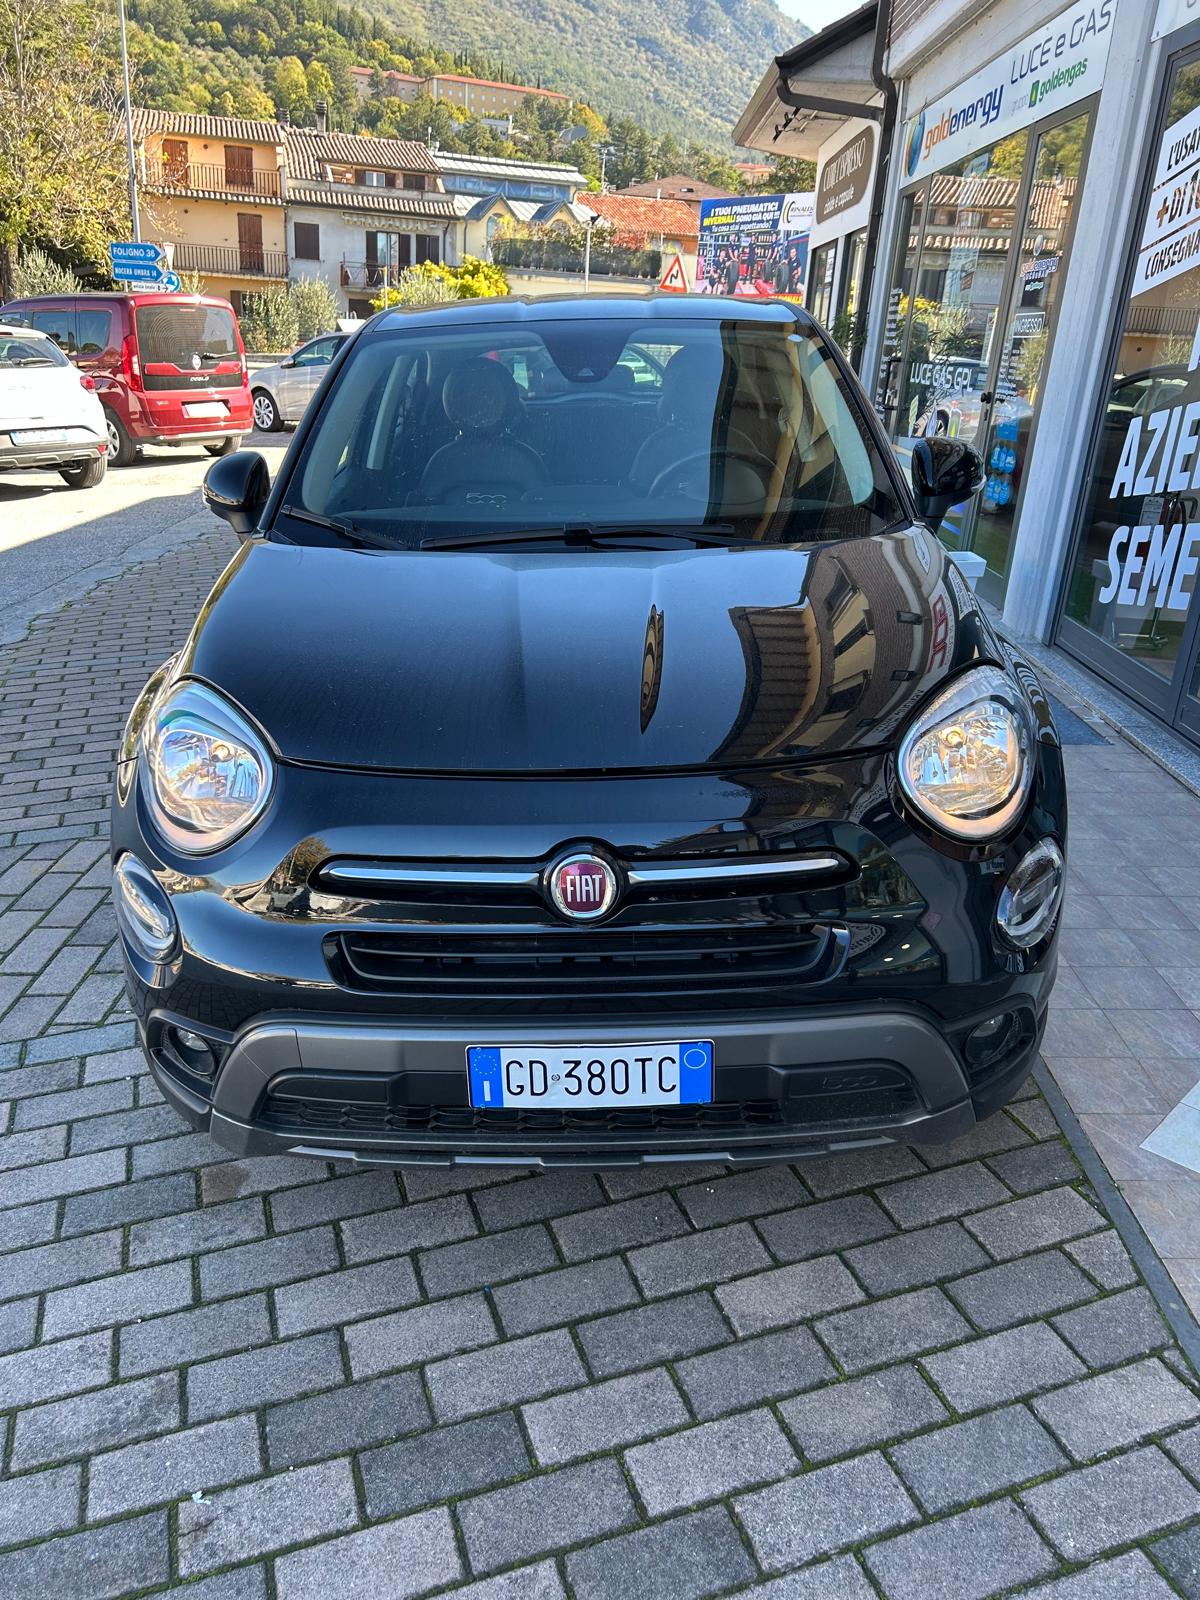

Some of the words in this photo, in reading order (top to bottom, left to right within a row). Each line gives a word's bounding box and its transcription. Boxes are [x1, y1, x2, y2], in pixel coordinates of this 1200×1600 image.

[1010, 36, 1052, 85] LUCE
[1054, 33, 1067, 58] e
[1070, 0, 1112, 48] GAS
[1039, 57, 1088, 103] goldengas
[923, 85, 1004, 159] goldenergy
[703, 215, 736, 227] INVERNALI
[736, 213, 752, 223] SONO
[715, 206, 732, 216] TUOI
[731, 201, 779, 214] PNEUMATICI
[740, 221, 772, 232] aspettando?
[113, 247, 145, 257] FOLIGNO
[114, 267, 133, 276] NOCERA
[133, 268, 150, 277] UMBRA
[910, 362, 933, 386] LUCE
[932, 364, 954, 389] GAS
[954, 367, 973, 392] GPL
[1109, 401, 1200, 499] AZIE
[1099, 523, 1200, 610] SEME
[566, 874, 602, 902] FIAT
